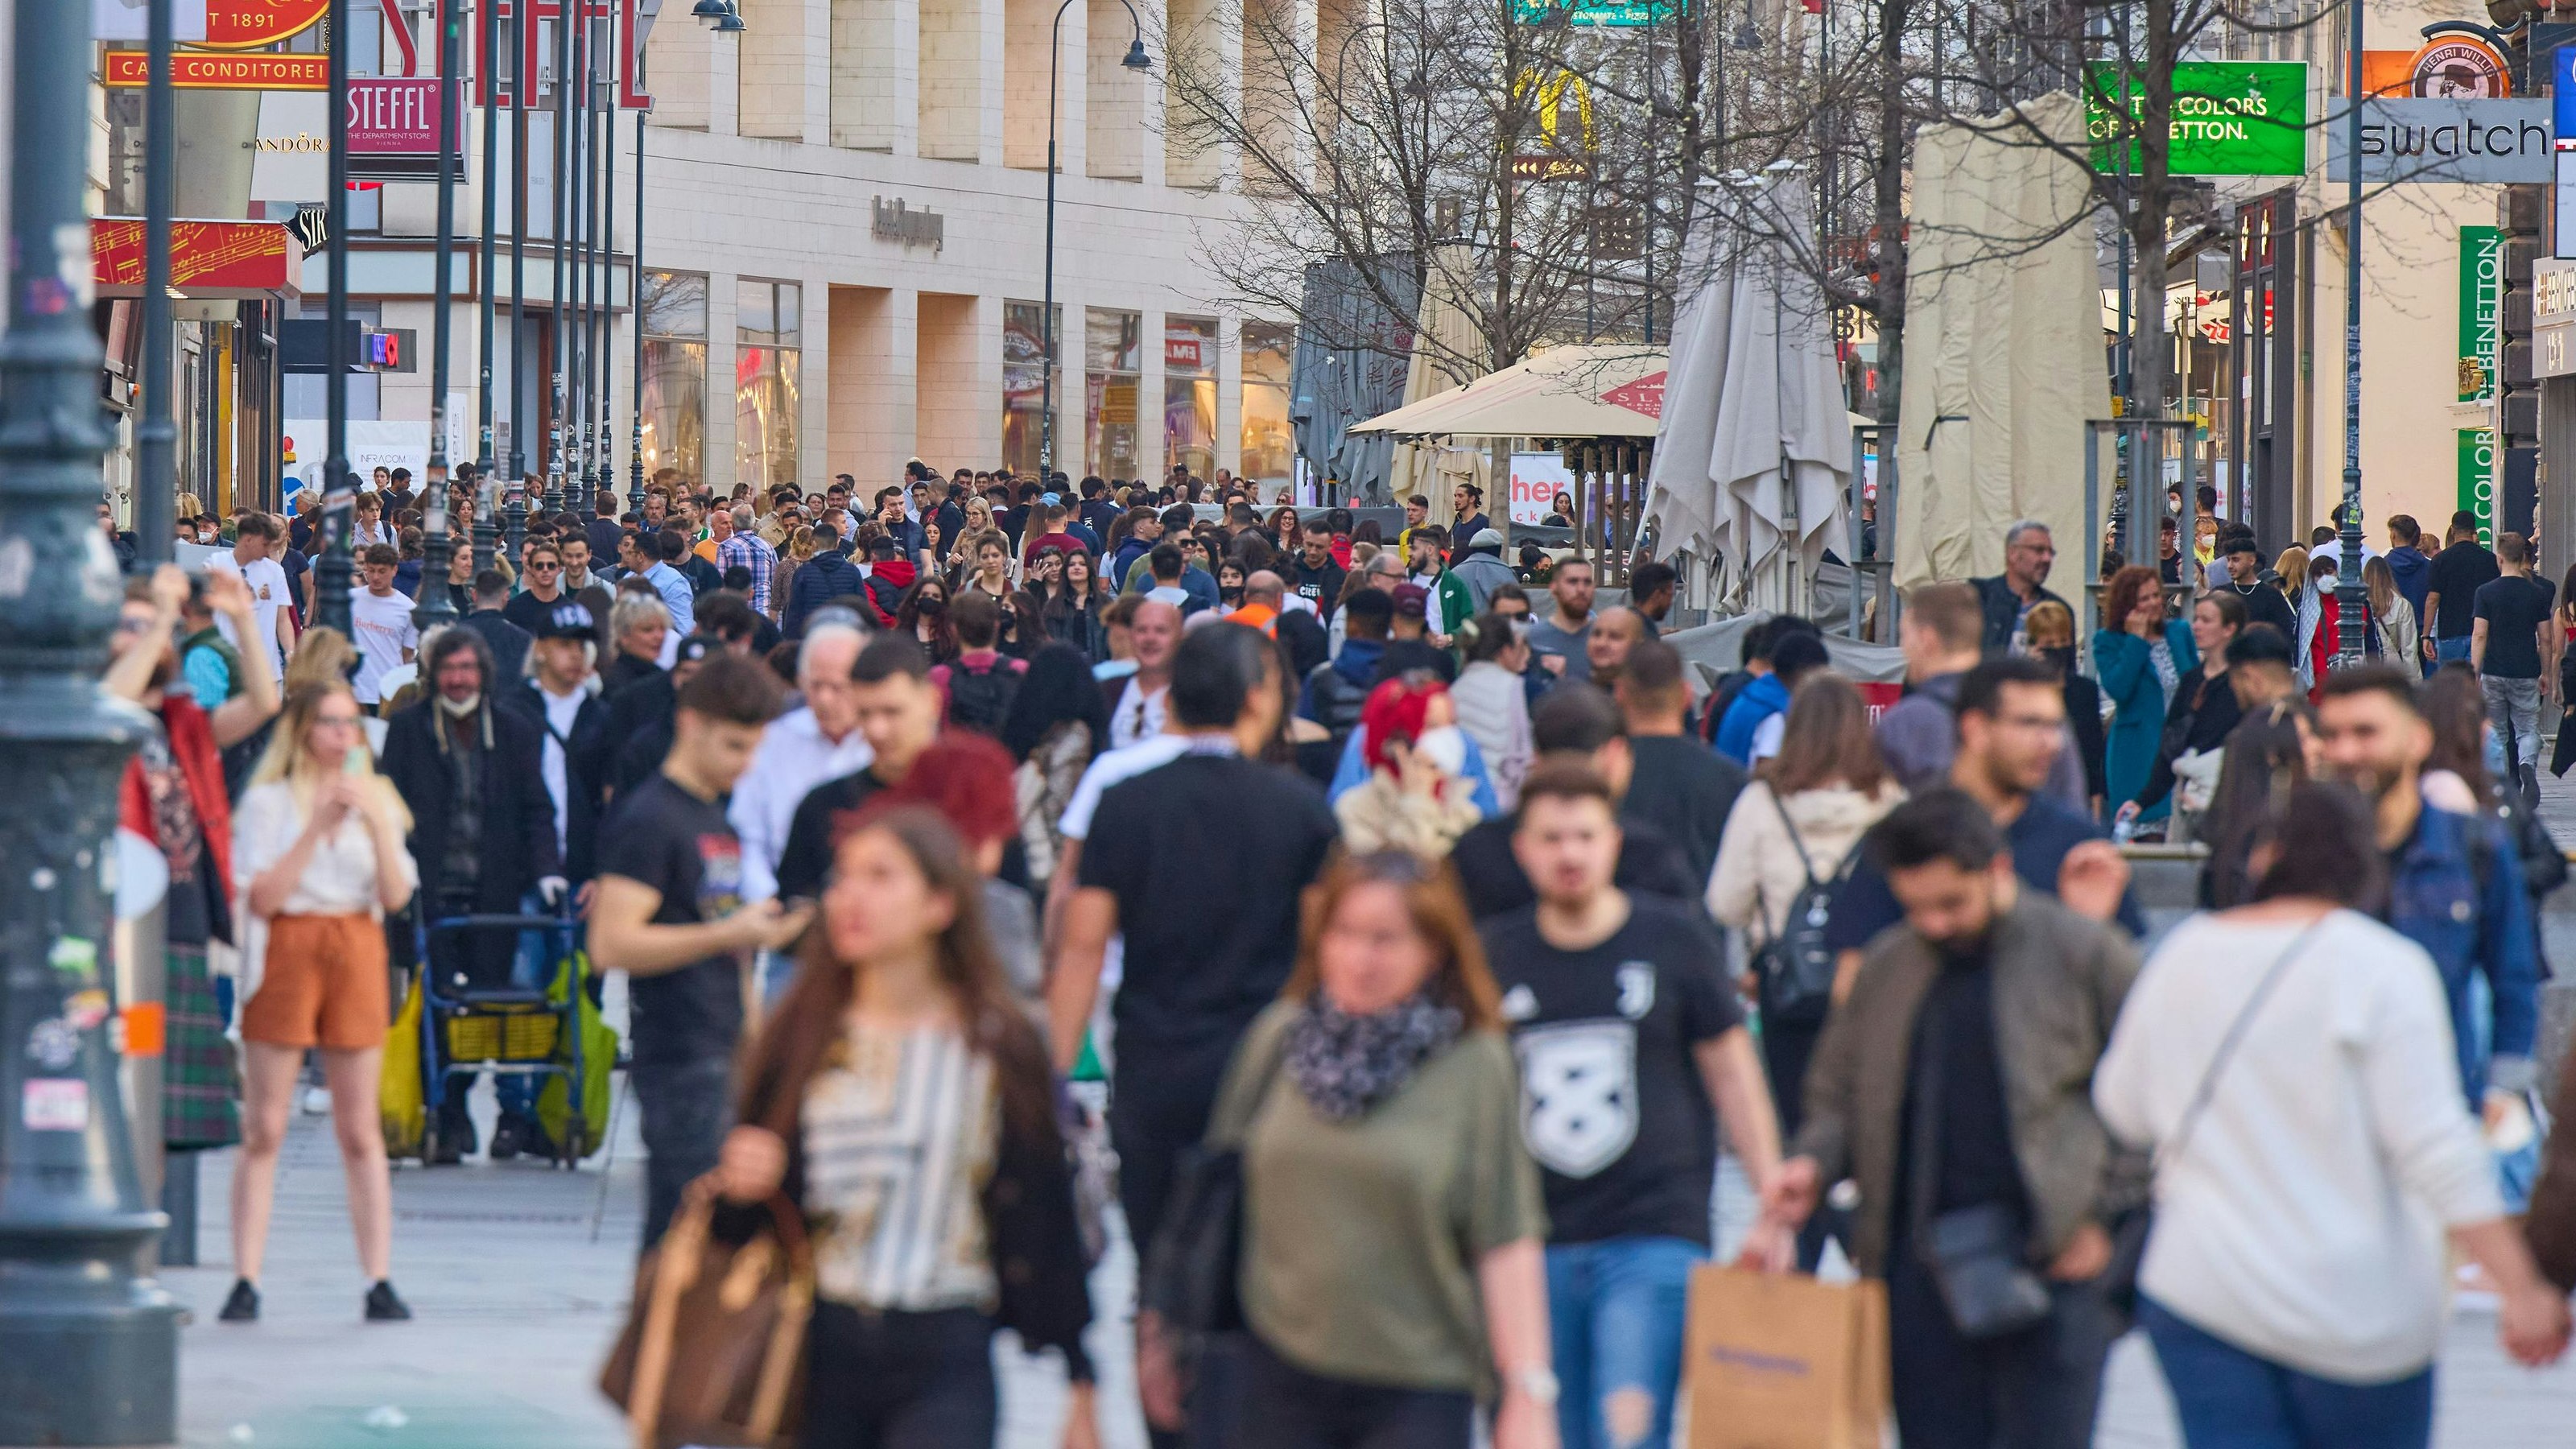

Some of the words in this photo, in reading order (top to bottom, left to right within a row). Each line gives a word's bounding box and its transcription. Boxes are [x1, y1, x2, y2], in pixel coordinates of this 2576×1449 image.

[231, 14, 274, 27] 1891
[122, 60, 175, 76] CAÉ
[188, 62, 324, 79] CONDITOREI
[2422, 49, 2456, 72] HENRI
[2461, 48, 2496, 77] WILLIG
[2179, 97, 2267, 116] COLORS
[2361, 118, 2547, 156] swatch
[2477, 235, 2497, 369] BENETTON.
